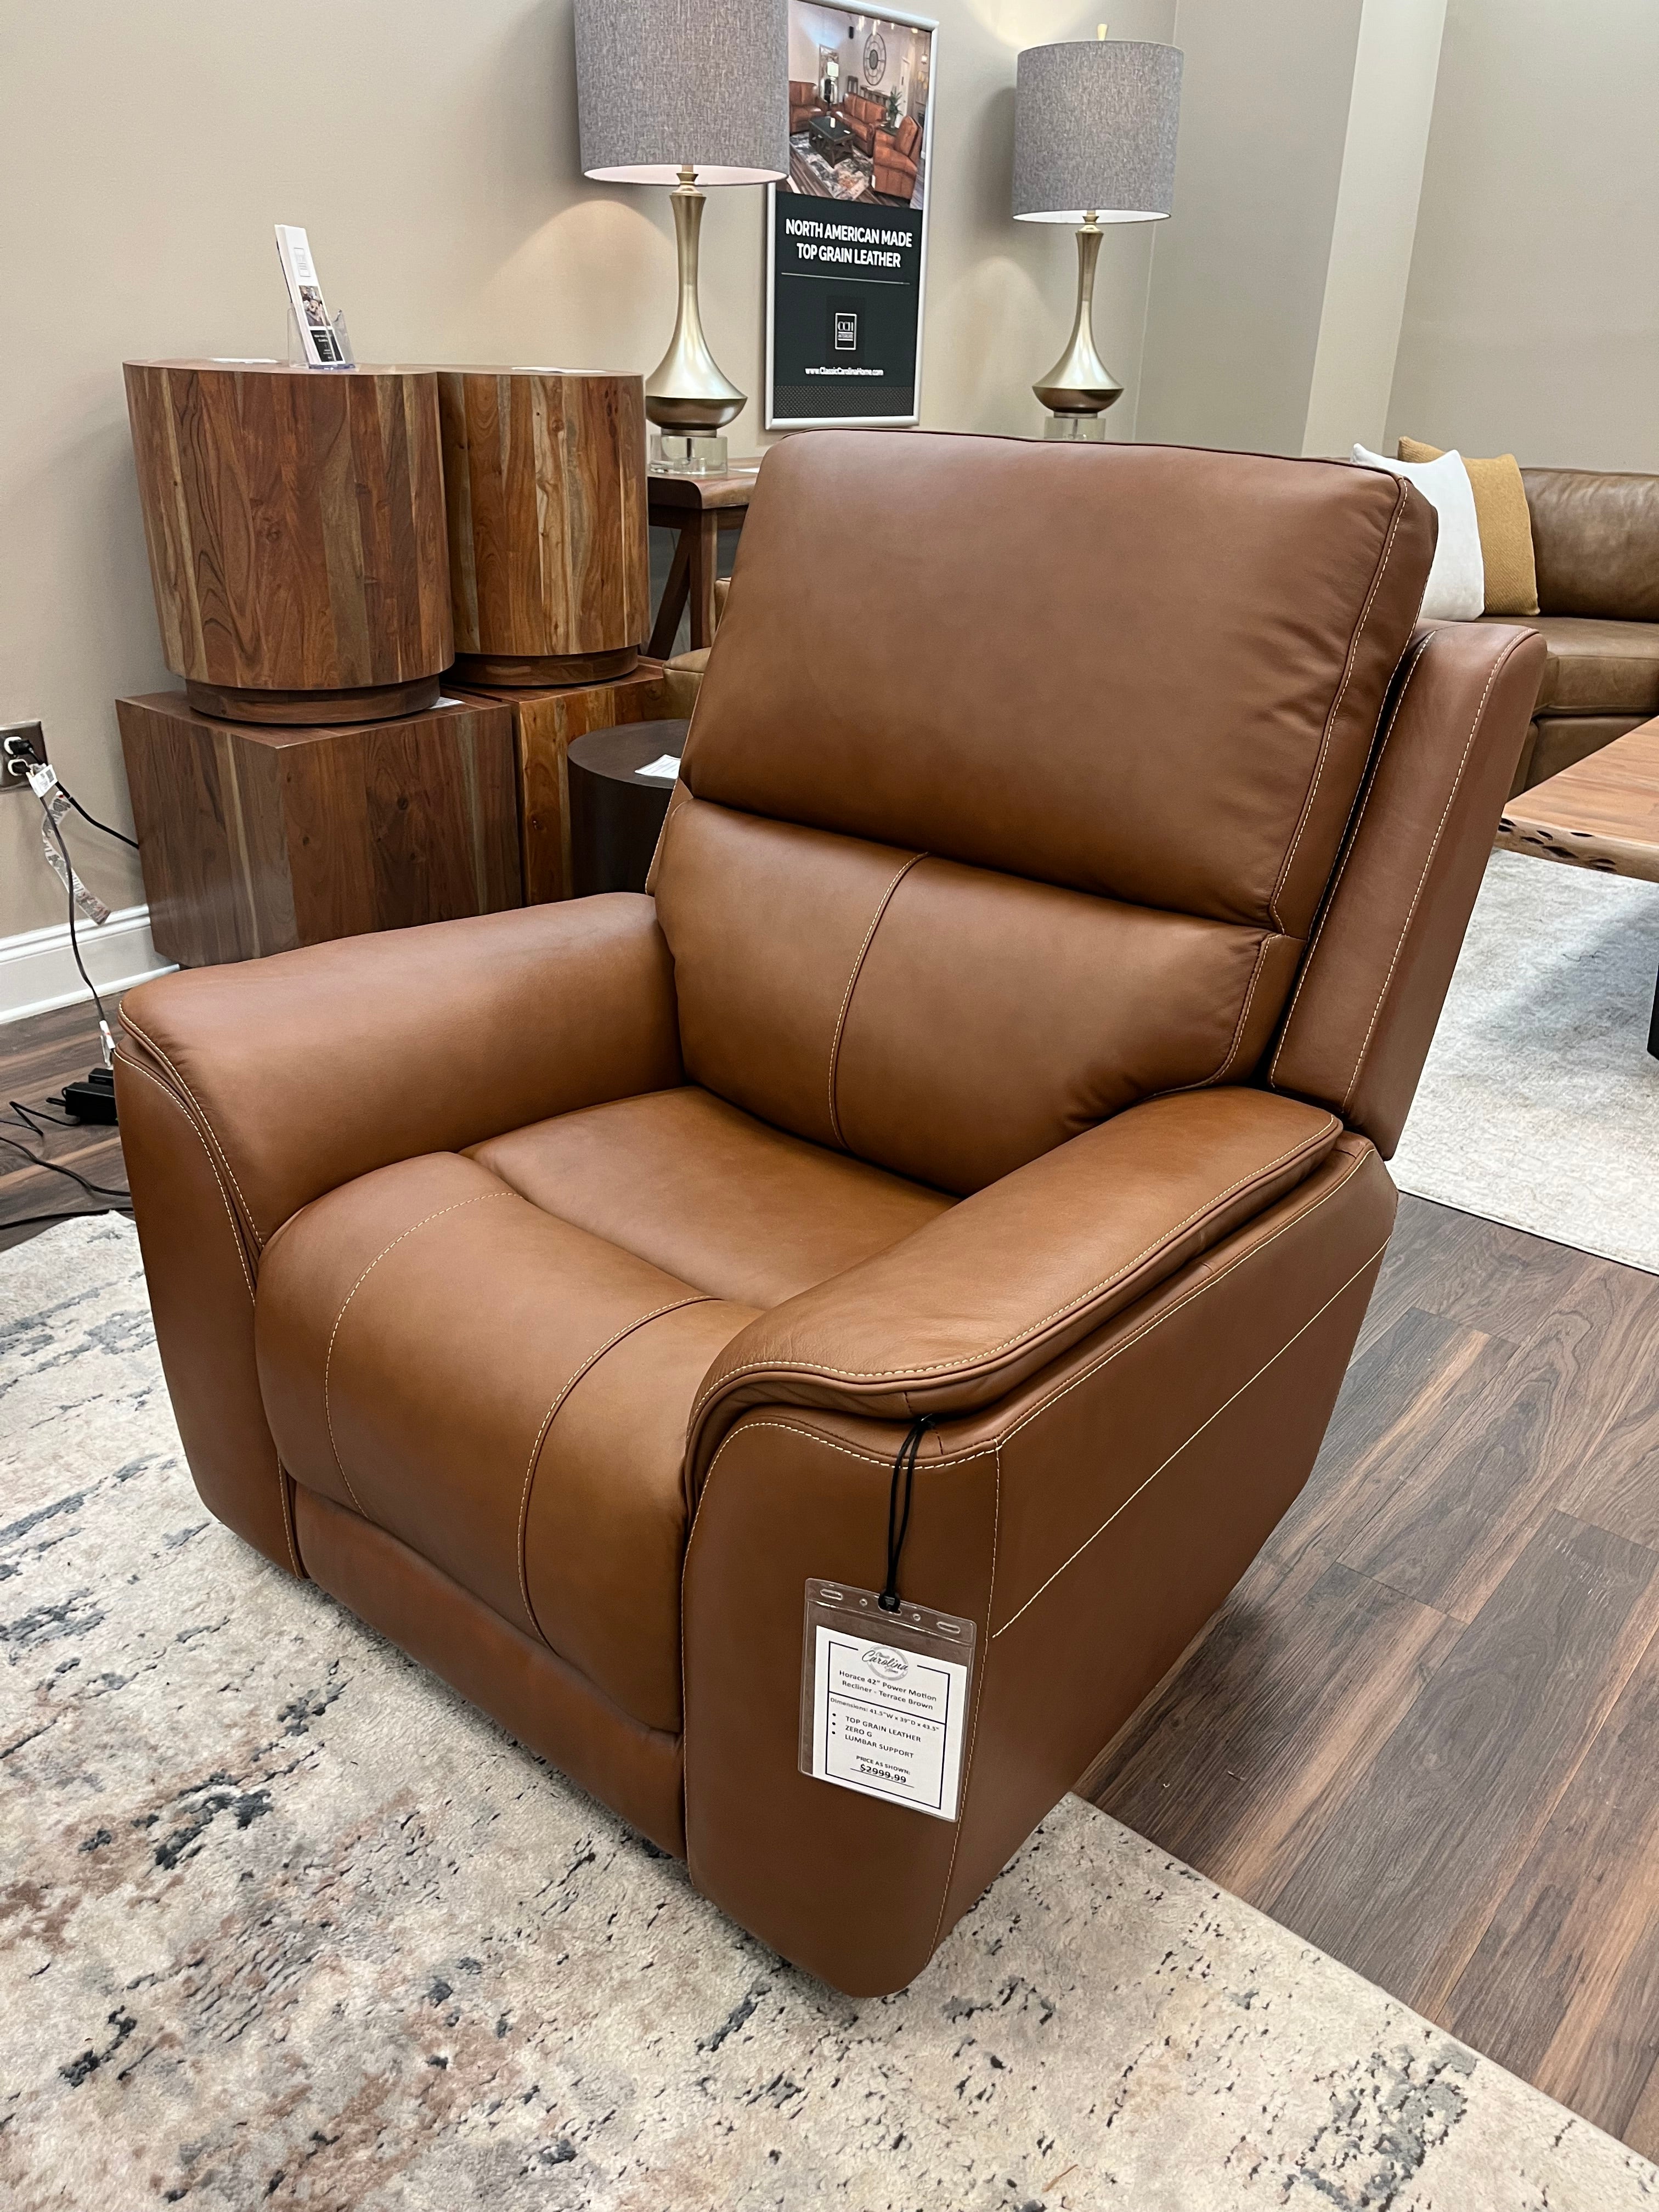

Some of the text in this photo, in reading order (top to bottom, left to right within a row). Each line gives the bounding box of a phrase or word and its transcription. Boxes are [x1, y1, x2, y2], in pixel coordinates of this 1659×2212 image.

[786, 218, 913, 247] NORTH AMERICAN MADE
[797, 242, 901, 268] TOP GRAIN LEATHER
[862, 1650, 909, 1671] Carolina
[839, 1670, 865, 1682] Horace
[882, 1681, 906, 1694] Power
[909, 1689, 937, 1701] Motion
[842, 1680, 872, 1693] Recliner
[879, 1690, 906, 1703] Terrace
[909, 1699, 933, 1710] Brown
[830, 1697, 868, 1712] Dimensions:
[845, 1716, 921, 1742] TOP GRAIN LEATHER
[845, 1725, 865, 1735] ZERO
[845, 1734, 914, 1758] LUMBAR SUPPORT
[856, 1756, 874, 1764] PRICE
[884, 1763, 911, 1775] SHOWN:
[860, 1764, 906, 1783] $2999.99
